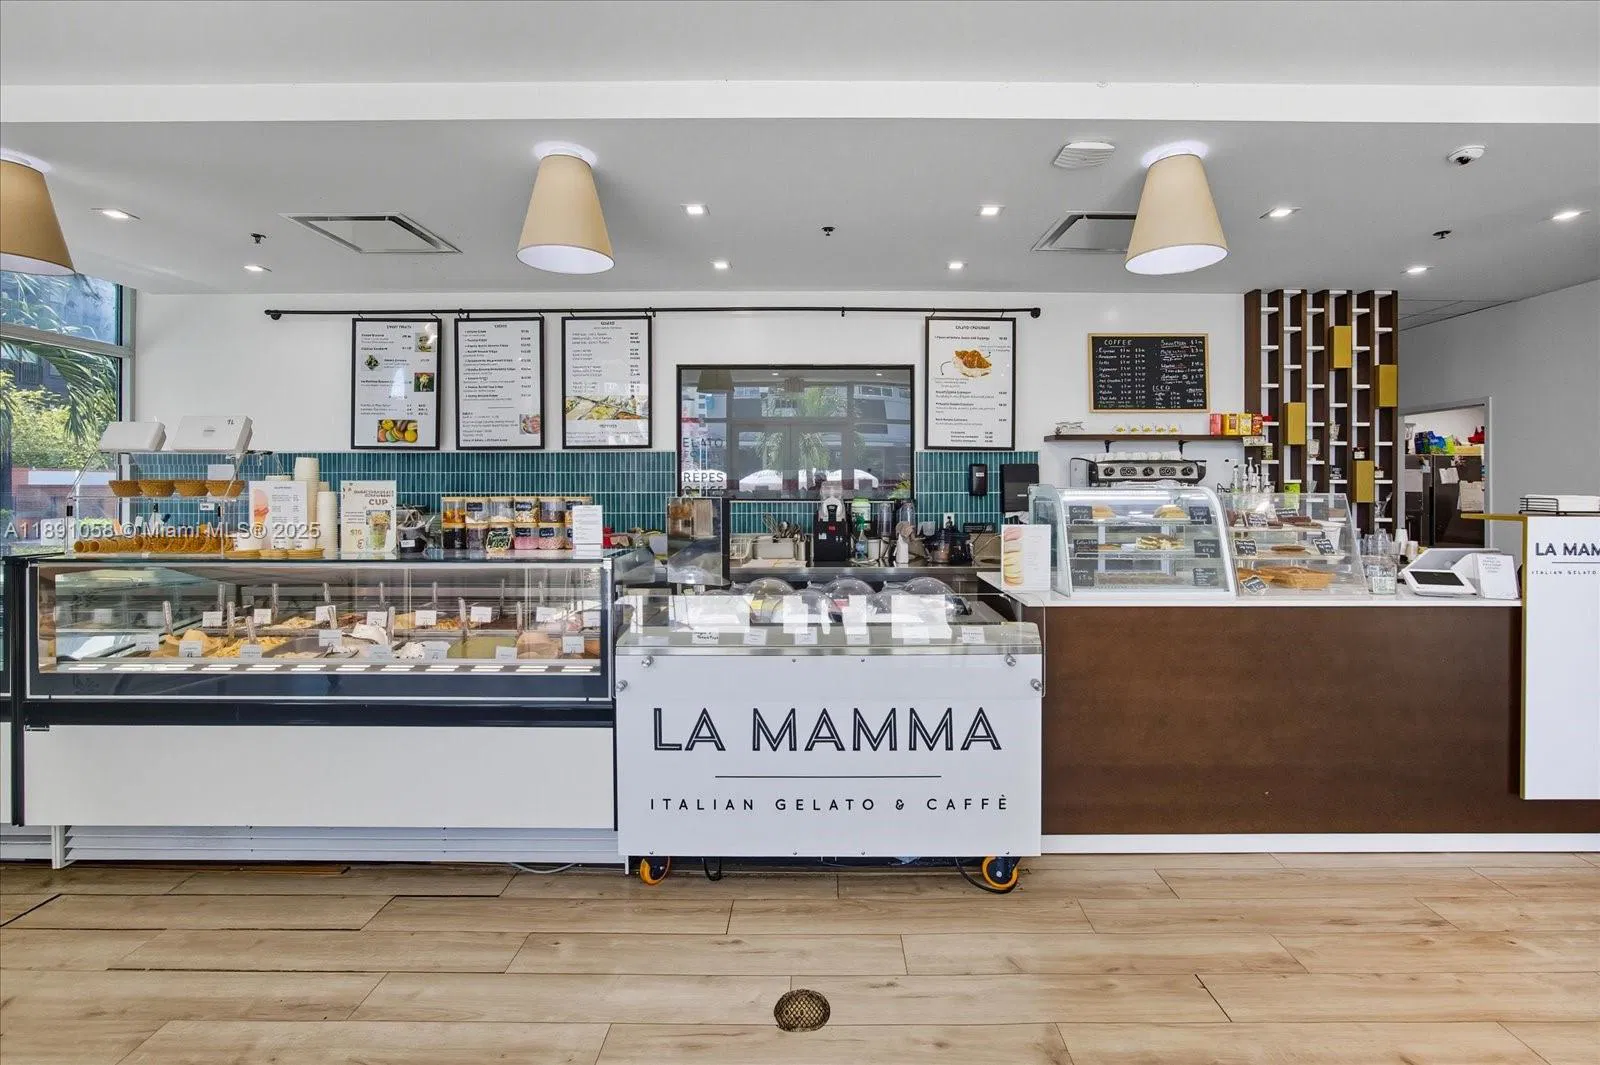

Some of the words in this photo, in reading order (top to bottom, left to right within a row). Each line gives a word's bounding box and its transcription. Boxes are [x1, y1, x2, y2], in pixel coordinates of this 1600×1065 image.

[1536, 542, 1557, 555] LA
[653, 707, 726, 751] LA
[752, 707, 1002, 751] MAMMA
[650, 798, 753, 811] ITALIAN
[775, 798, 874, 811] GELATO
[895, 799, 905, 811] &
[926, 794, 1008, 811] CAFFÈ
